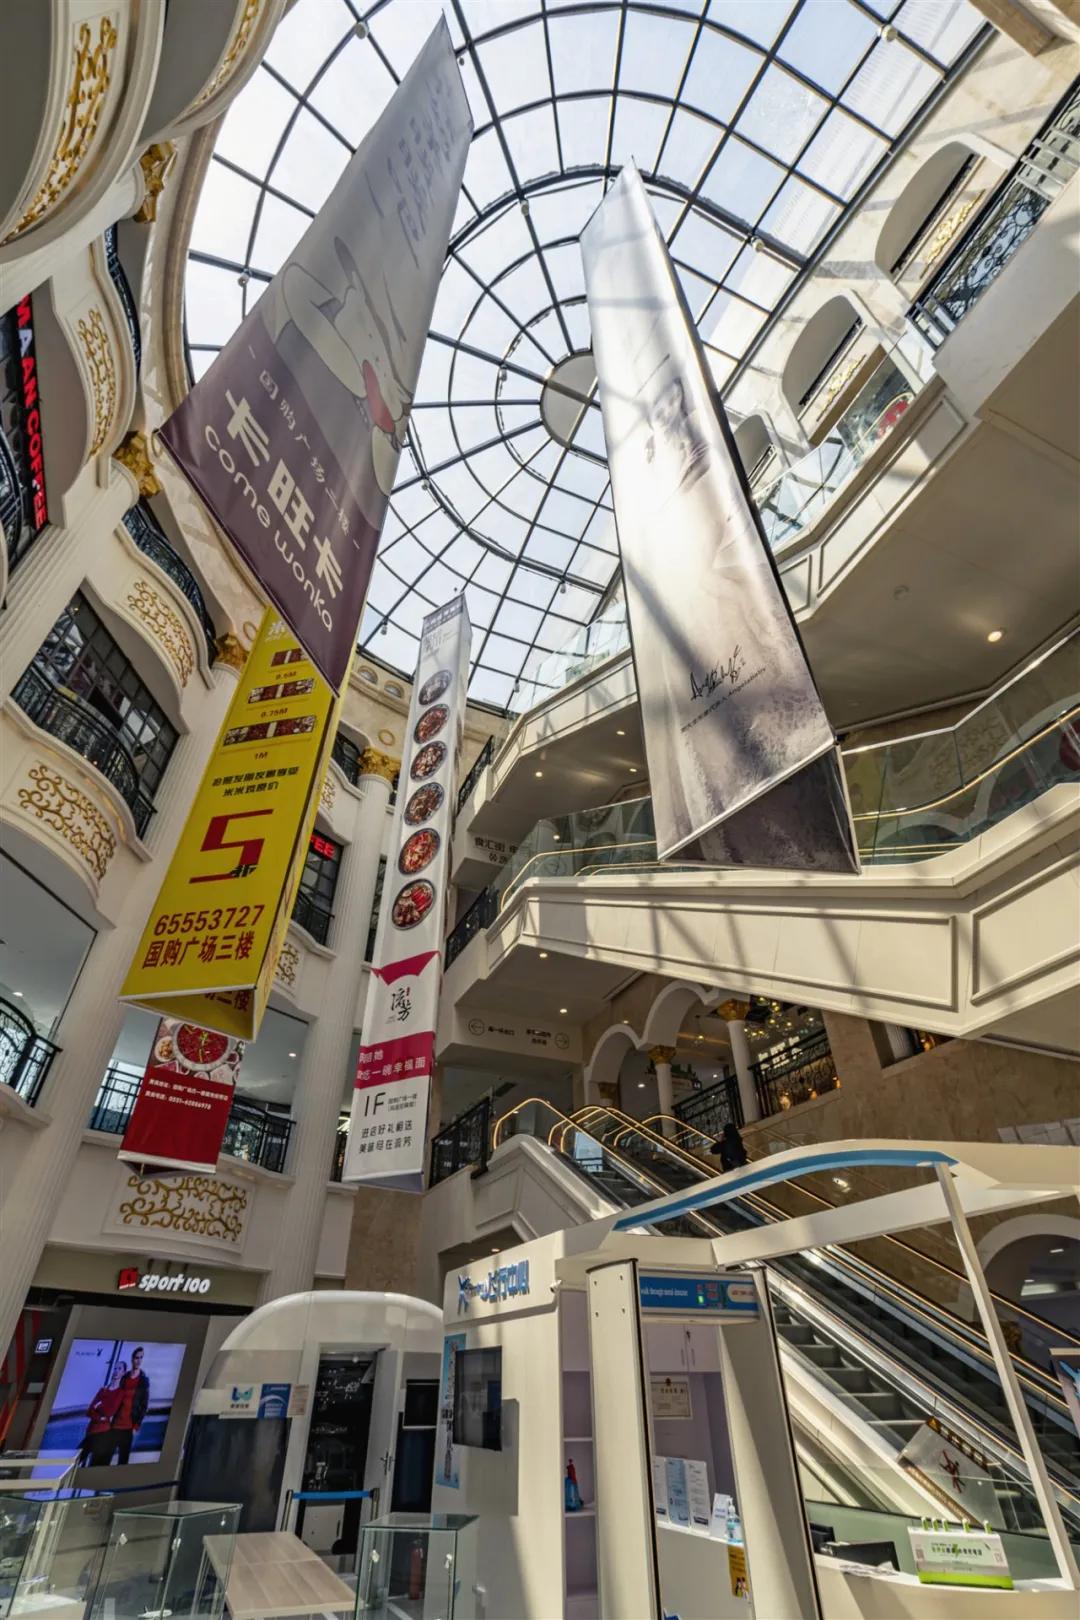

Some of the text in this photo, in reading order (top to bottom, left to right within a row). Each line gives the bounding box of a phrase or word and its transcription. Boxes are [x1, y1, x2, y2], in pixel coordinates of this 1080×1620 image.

[23, 414, 48, 531] COFFEE
[225, 389, 344, 600] 卡旺卡
[153, 904, 265, 936] 65553727
[142, 931, 255, 969] 国购广场三楼
[138, 1273, 211, 1293] sport 100
